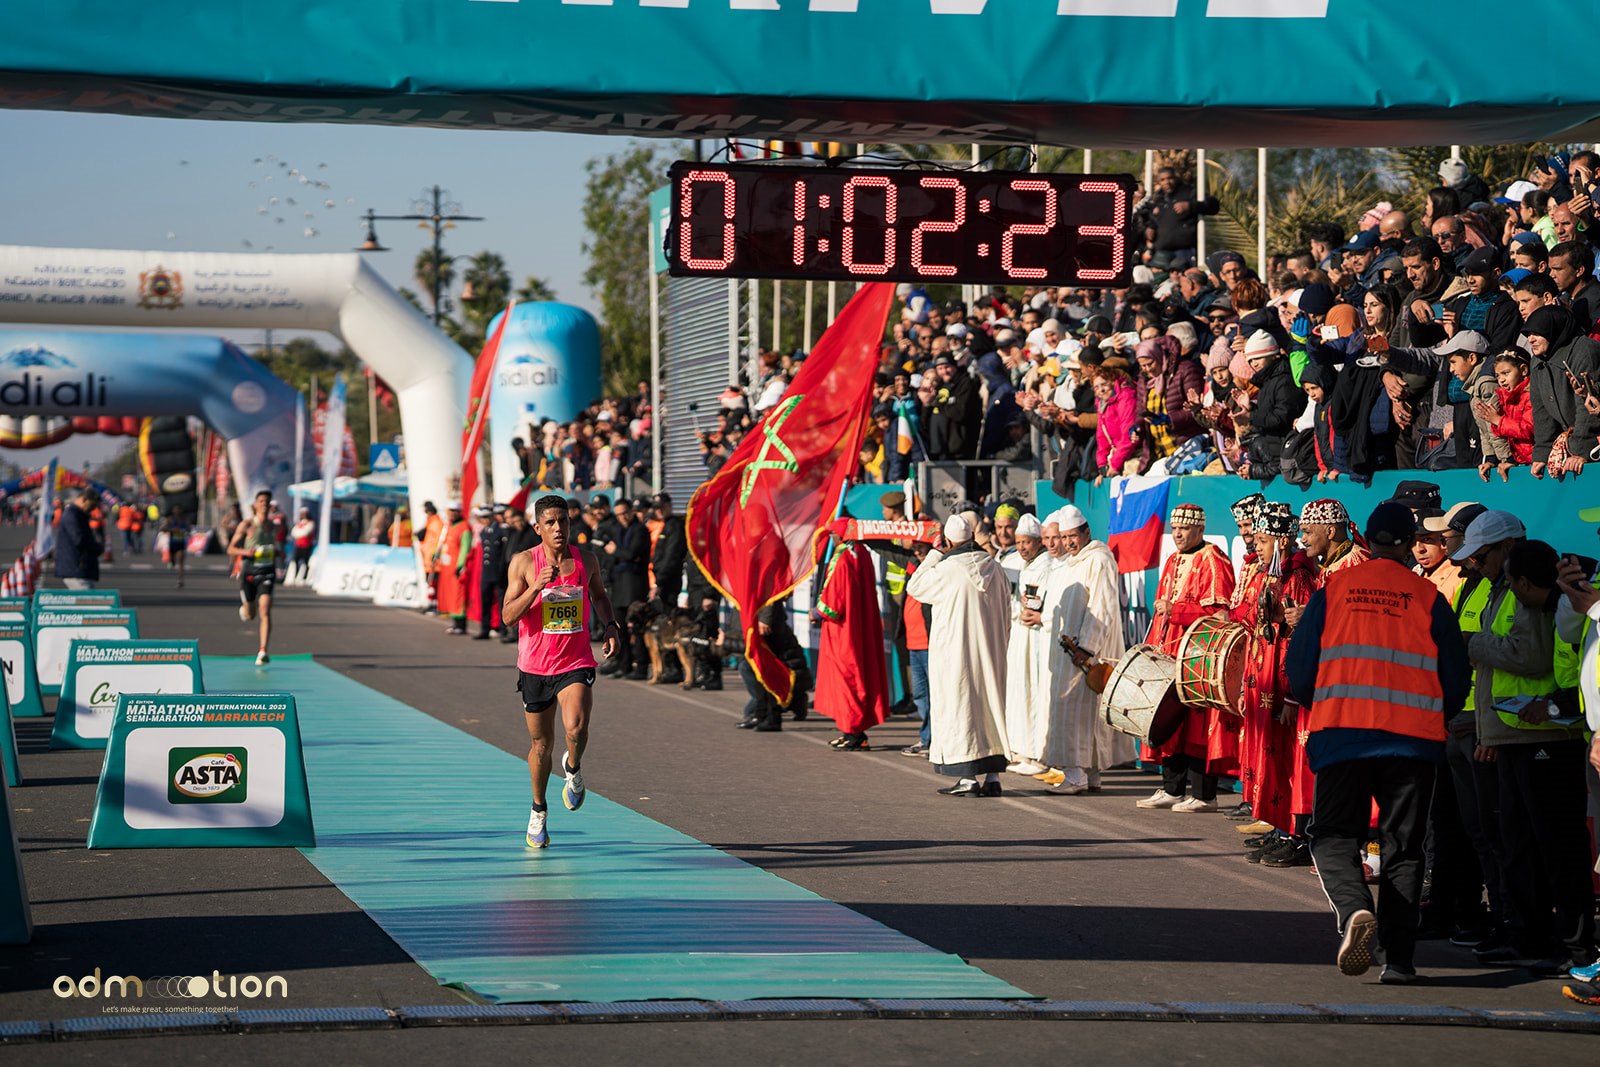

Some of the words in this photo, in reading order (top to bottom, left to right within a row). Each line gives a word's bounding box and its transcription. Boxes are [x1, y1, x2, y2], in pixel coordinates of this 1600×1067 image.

[532, 366, 558, 386] ali
[0, 372, 43, 406] di
[52, 372, 107, 406] ali
[863, 520, 919, 536] MOROCCO
[1348, 588, 1398, 599] MARATHON
[1345, 596, 1400, 608] MARRAKECH
[549, 605, 578, 619] 7668
[76, 648, 134, 656] MARATHON
[126, 704, 205, 715] MARATHON
[126, 714, 204, 722] SEMI-MARATHON
[204, 713, 285, 722] MARRAKECH
[179, 766, 240, 785] ASTA
